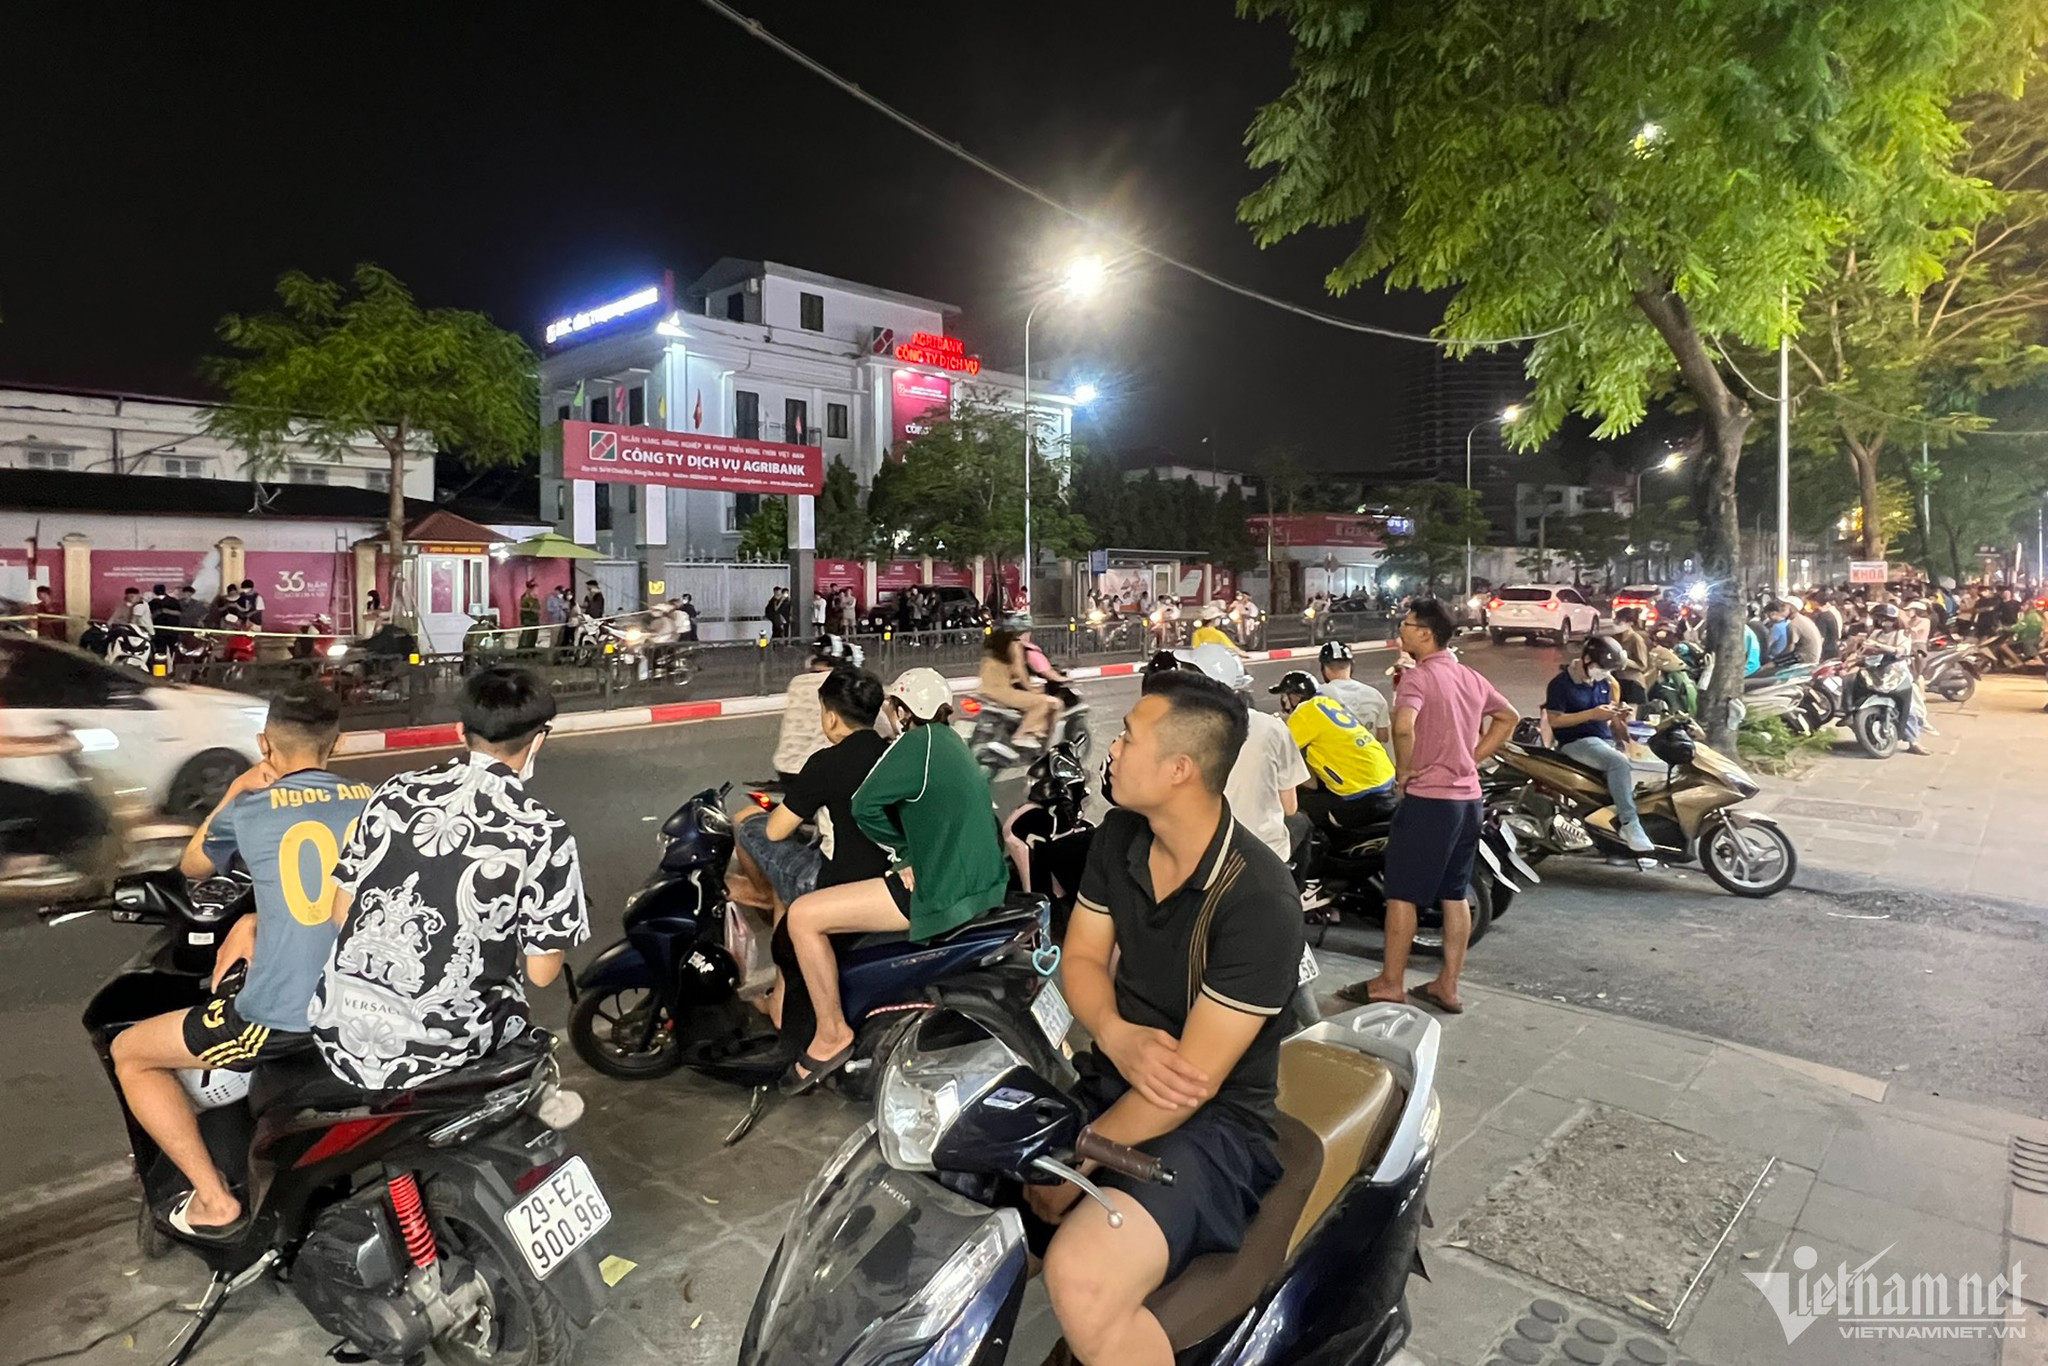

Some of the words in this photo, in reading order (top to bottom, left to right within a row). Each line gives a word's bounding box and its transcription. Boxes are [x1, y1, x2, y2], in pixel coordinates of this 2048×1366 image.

[912, 332, 964, 355] AGRIBANK
[895, 344, 924, 363] CÔNG
[925, 352, 939, 365] TY
[939, 354, 963, 370] DỊCH
[964, 358, 980, 376] VỤ
[621, 446, 664, 464] CÔNG
[665, 452, 684, 466] TY
[686, 454, 719, 470] DỊCH
[721, 458, 740, 473] VỤ
[742, 460, 806, 476] AGRIBANK
[520, 1170, 583, 1235] 29-E2
[531, 1194, 603, 1269] 900.96
